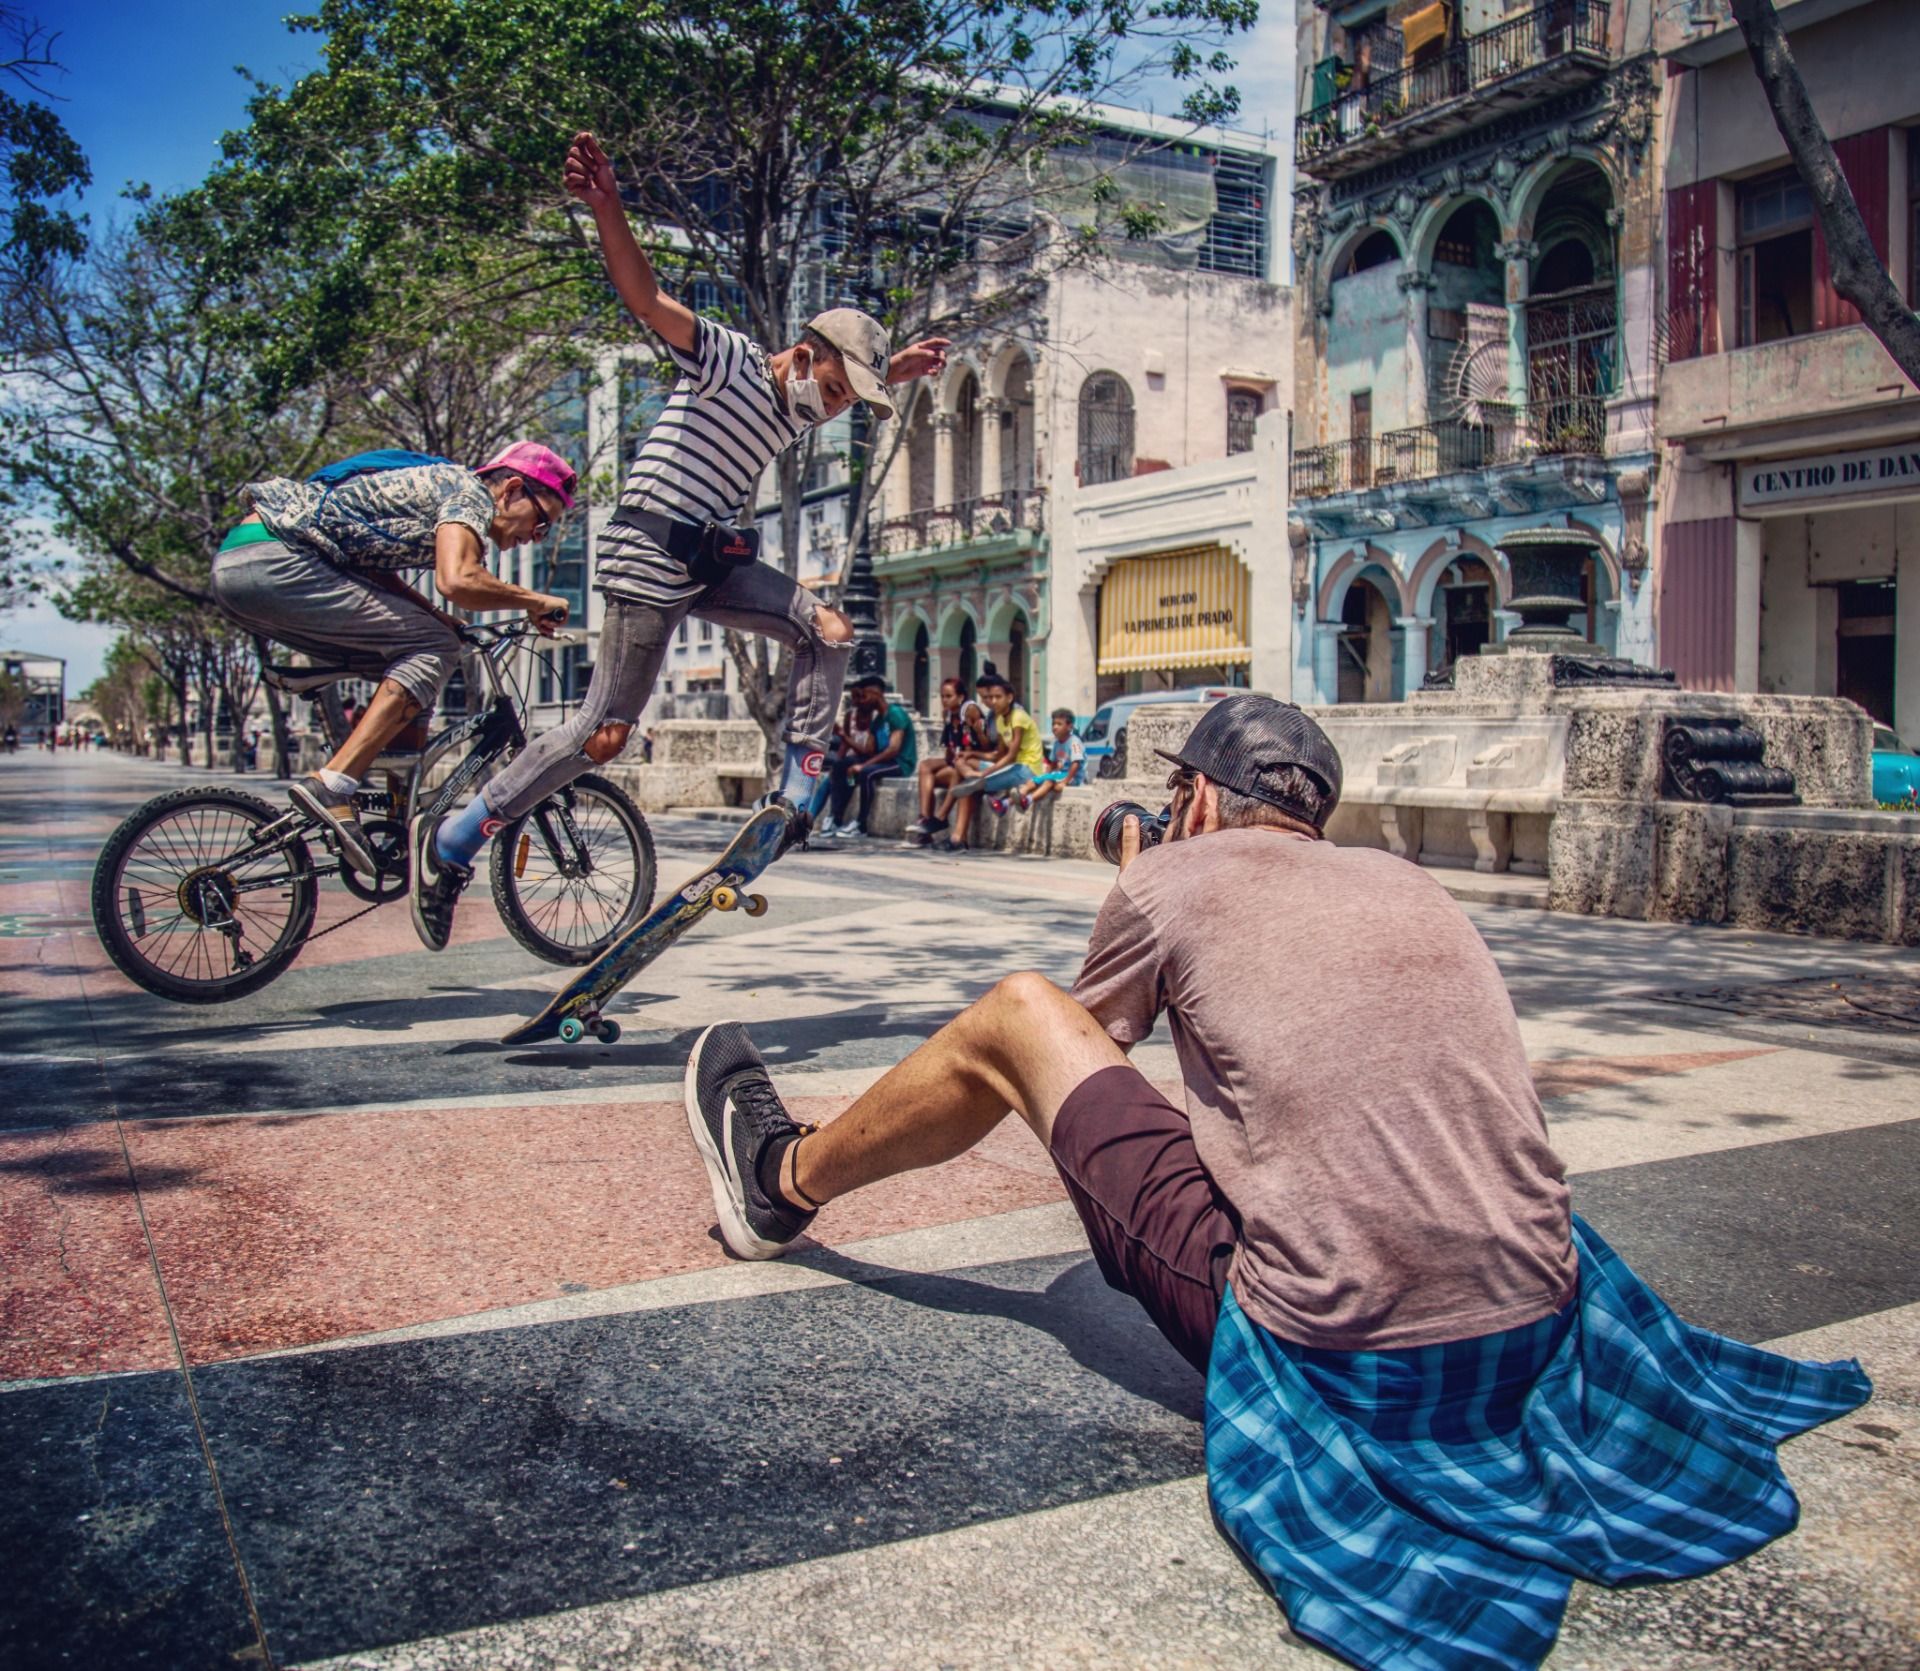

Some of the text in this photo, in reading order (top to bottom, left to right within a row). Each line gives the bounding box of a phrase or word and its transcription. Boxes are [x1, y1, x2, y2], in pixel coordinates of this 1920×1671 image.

[1753, 465, 1836, 494] CENTRO
[1842, 460, 1872, 483] DE
[1159, 592, 1197, 608] MERCADO
[1125, 609, 1232, 634] LA PRIMERA DE PRADO
[431, 750, 494, 816] ertical
